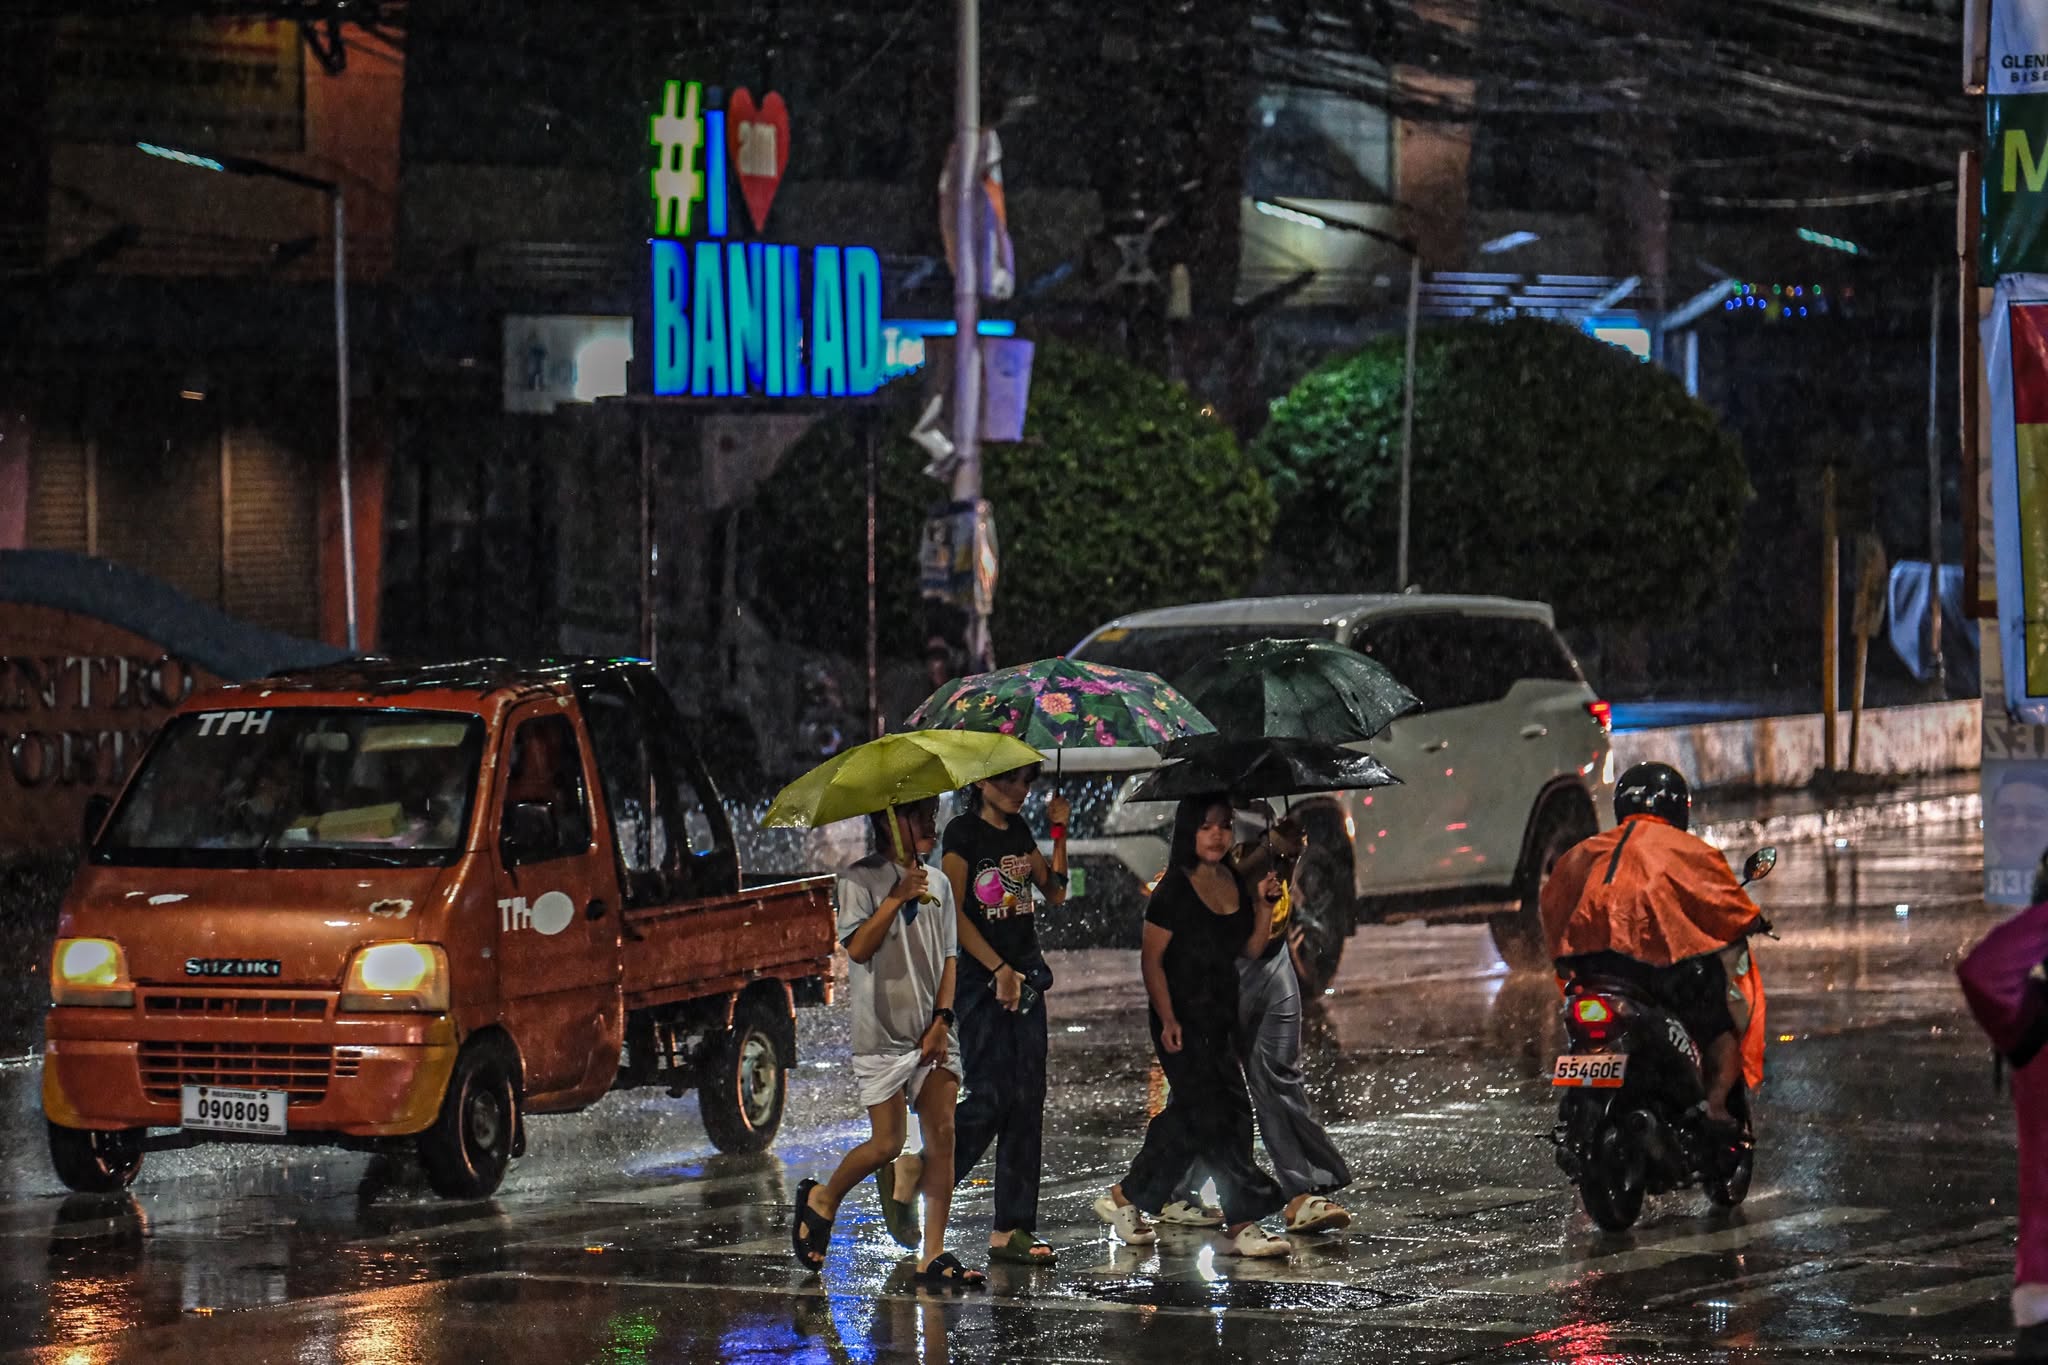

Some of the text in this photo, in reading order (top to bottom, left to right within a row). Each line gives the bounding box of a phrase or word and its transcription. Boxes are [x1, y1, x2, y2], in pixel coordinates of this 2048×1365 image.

[2001, 54, 2048, 69] GLEN
[651, 239, 882, 397] BANILAD
[197, 710, 273, 737] TPH
[986, 906, 1010, 920] PIT
[184, 958, 280, 975] SUZUKI
[198, 1099, 269, 1122] 090809
